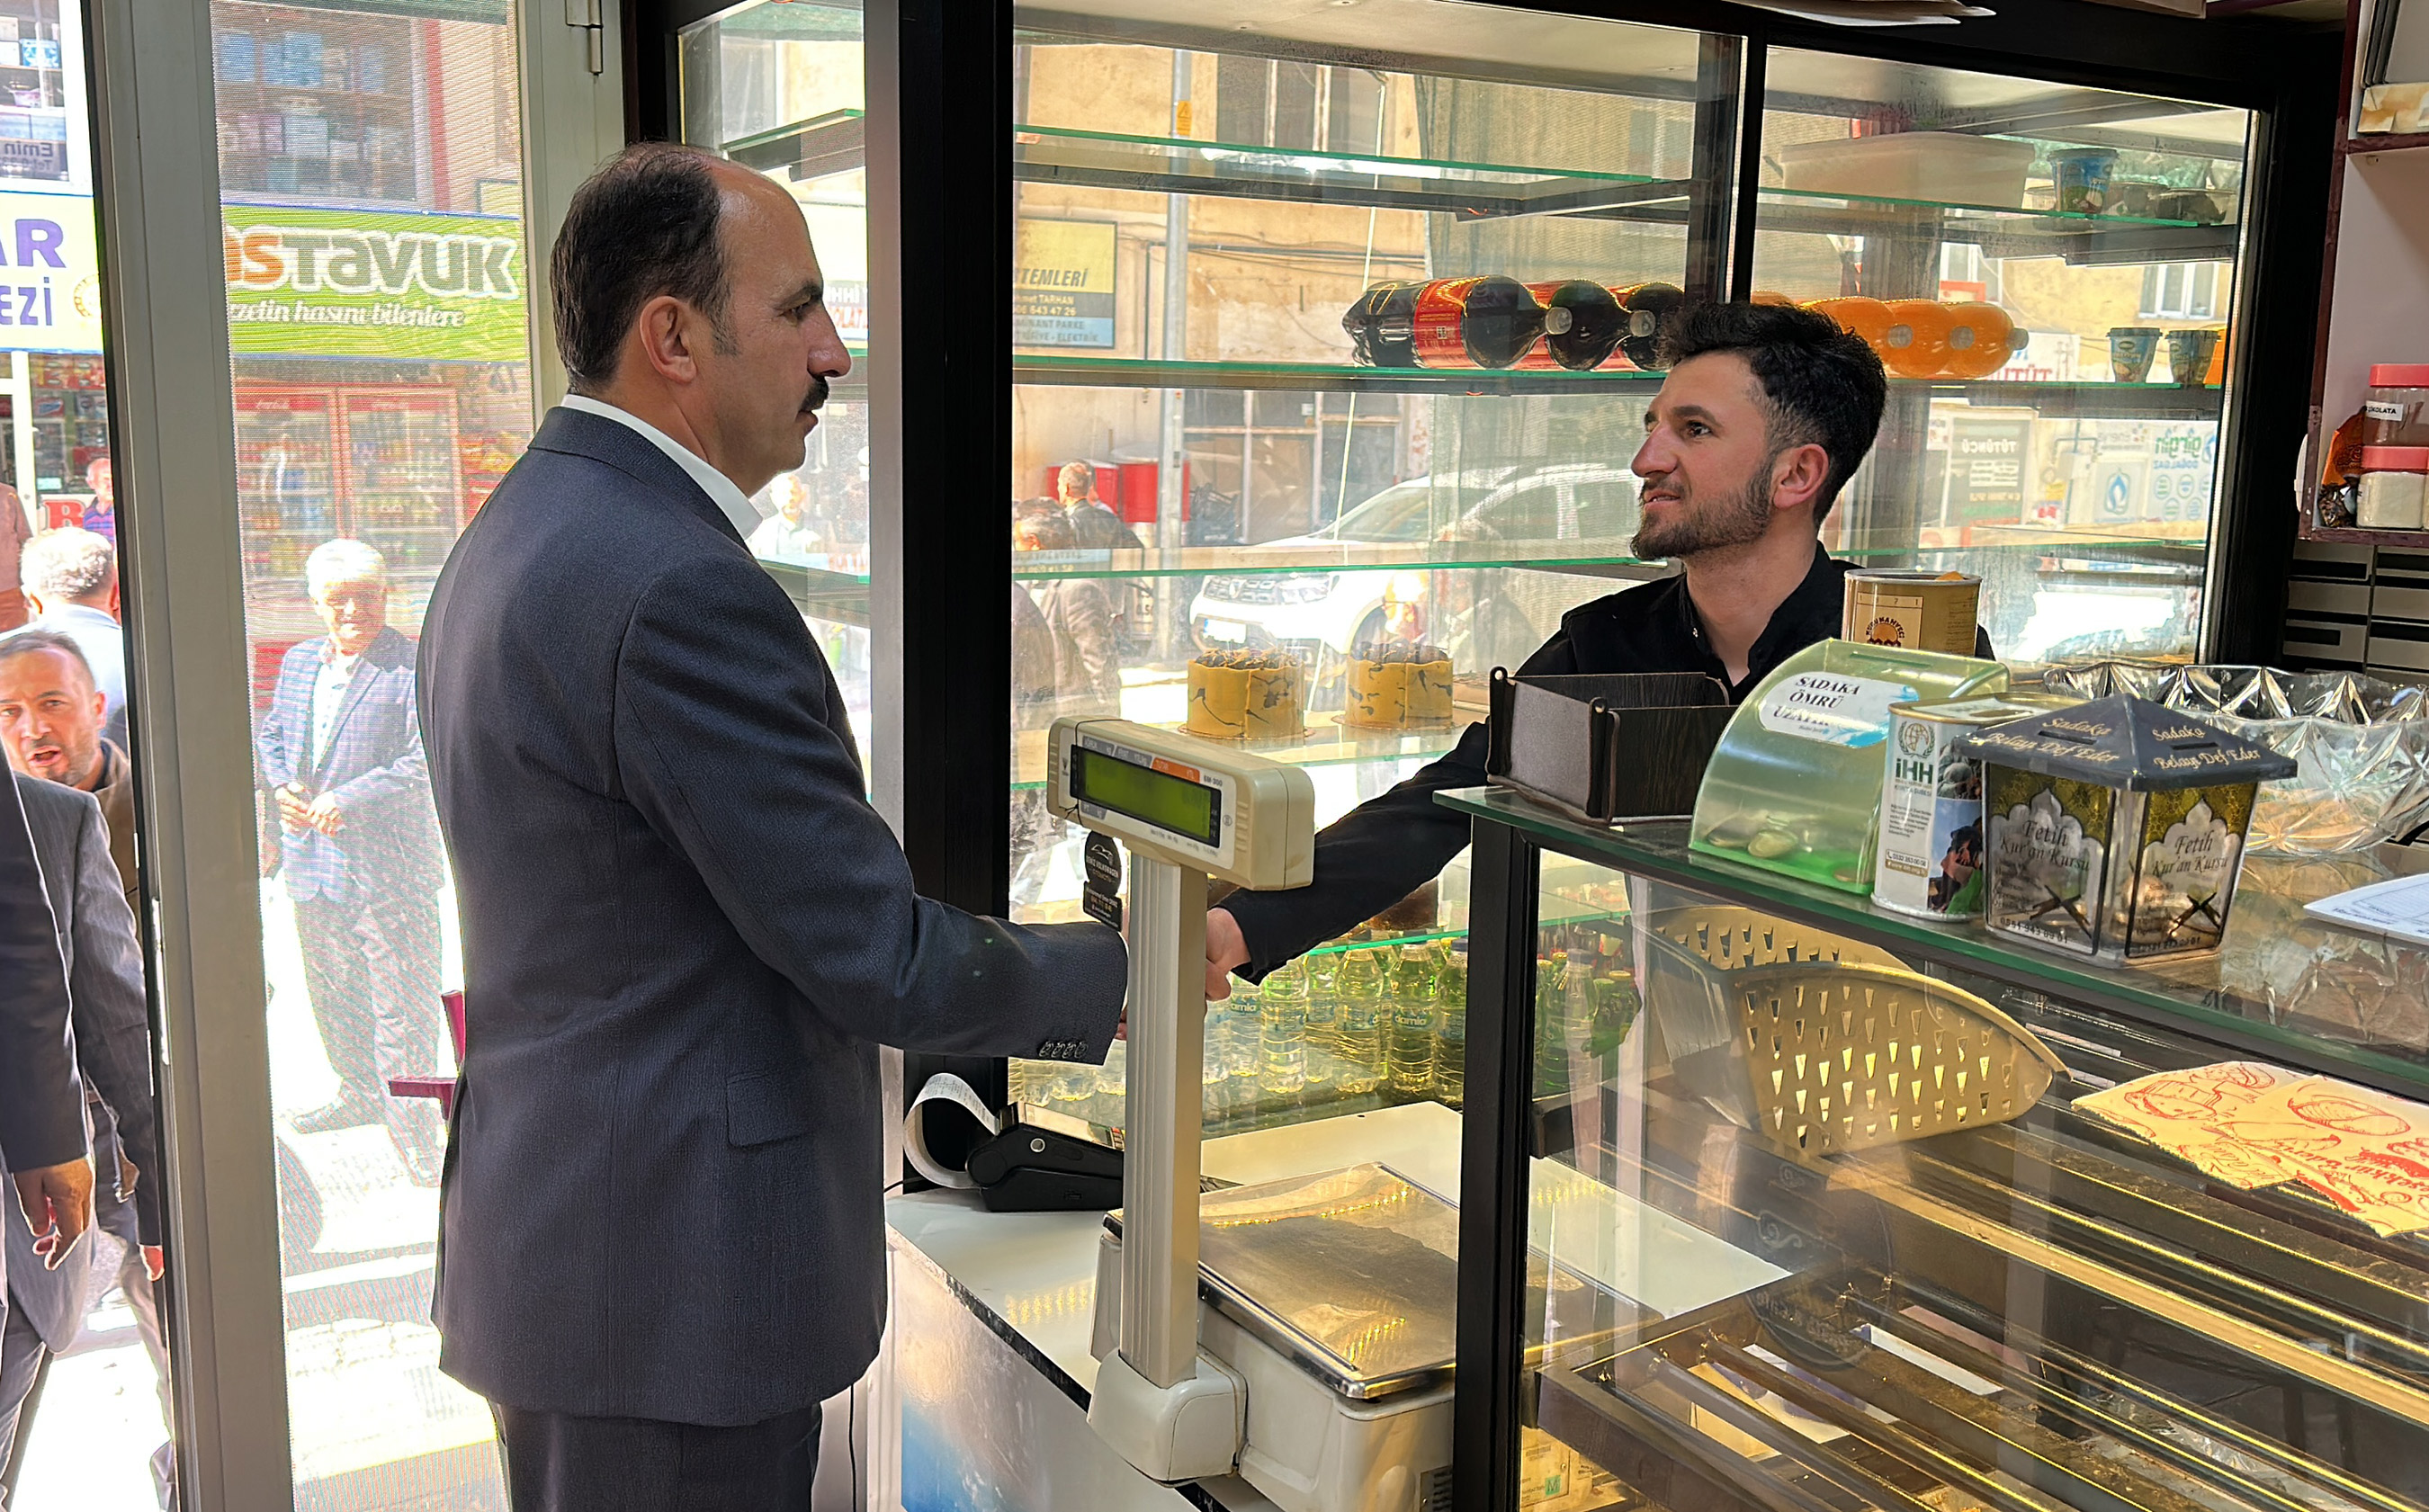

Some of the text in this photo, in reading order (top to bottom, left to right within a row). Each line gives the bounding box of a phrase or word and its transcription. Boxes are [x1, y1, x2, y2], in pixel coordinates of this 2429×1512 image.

[1795, 676, 1861, 695] SADAKA
[1789, 689, 1844, 709] ÖMRÜ
[2152, 725, 2205, 741] Sadaka
[2024, 820, 2068, 847] Fetih
[2174, 829, 2214, 855] Fetih
[2049, 848, 2090, 872] Kursu
[2194, 855, 2228, 873] Kursu
[1394, 1014, 1428, 1025] damla
